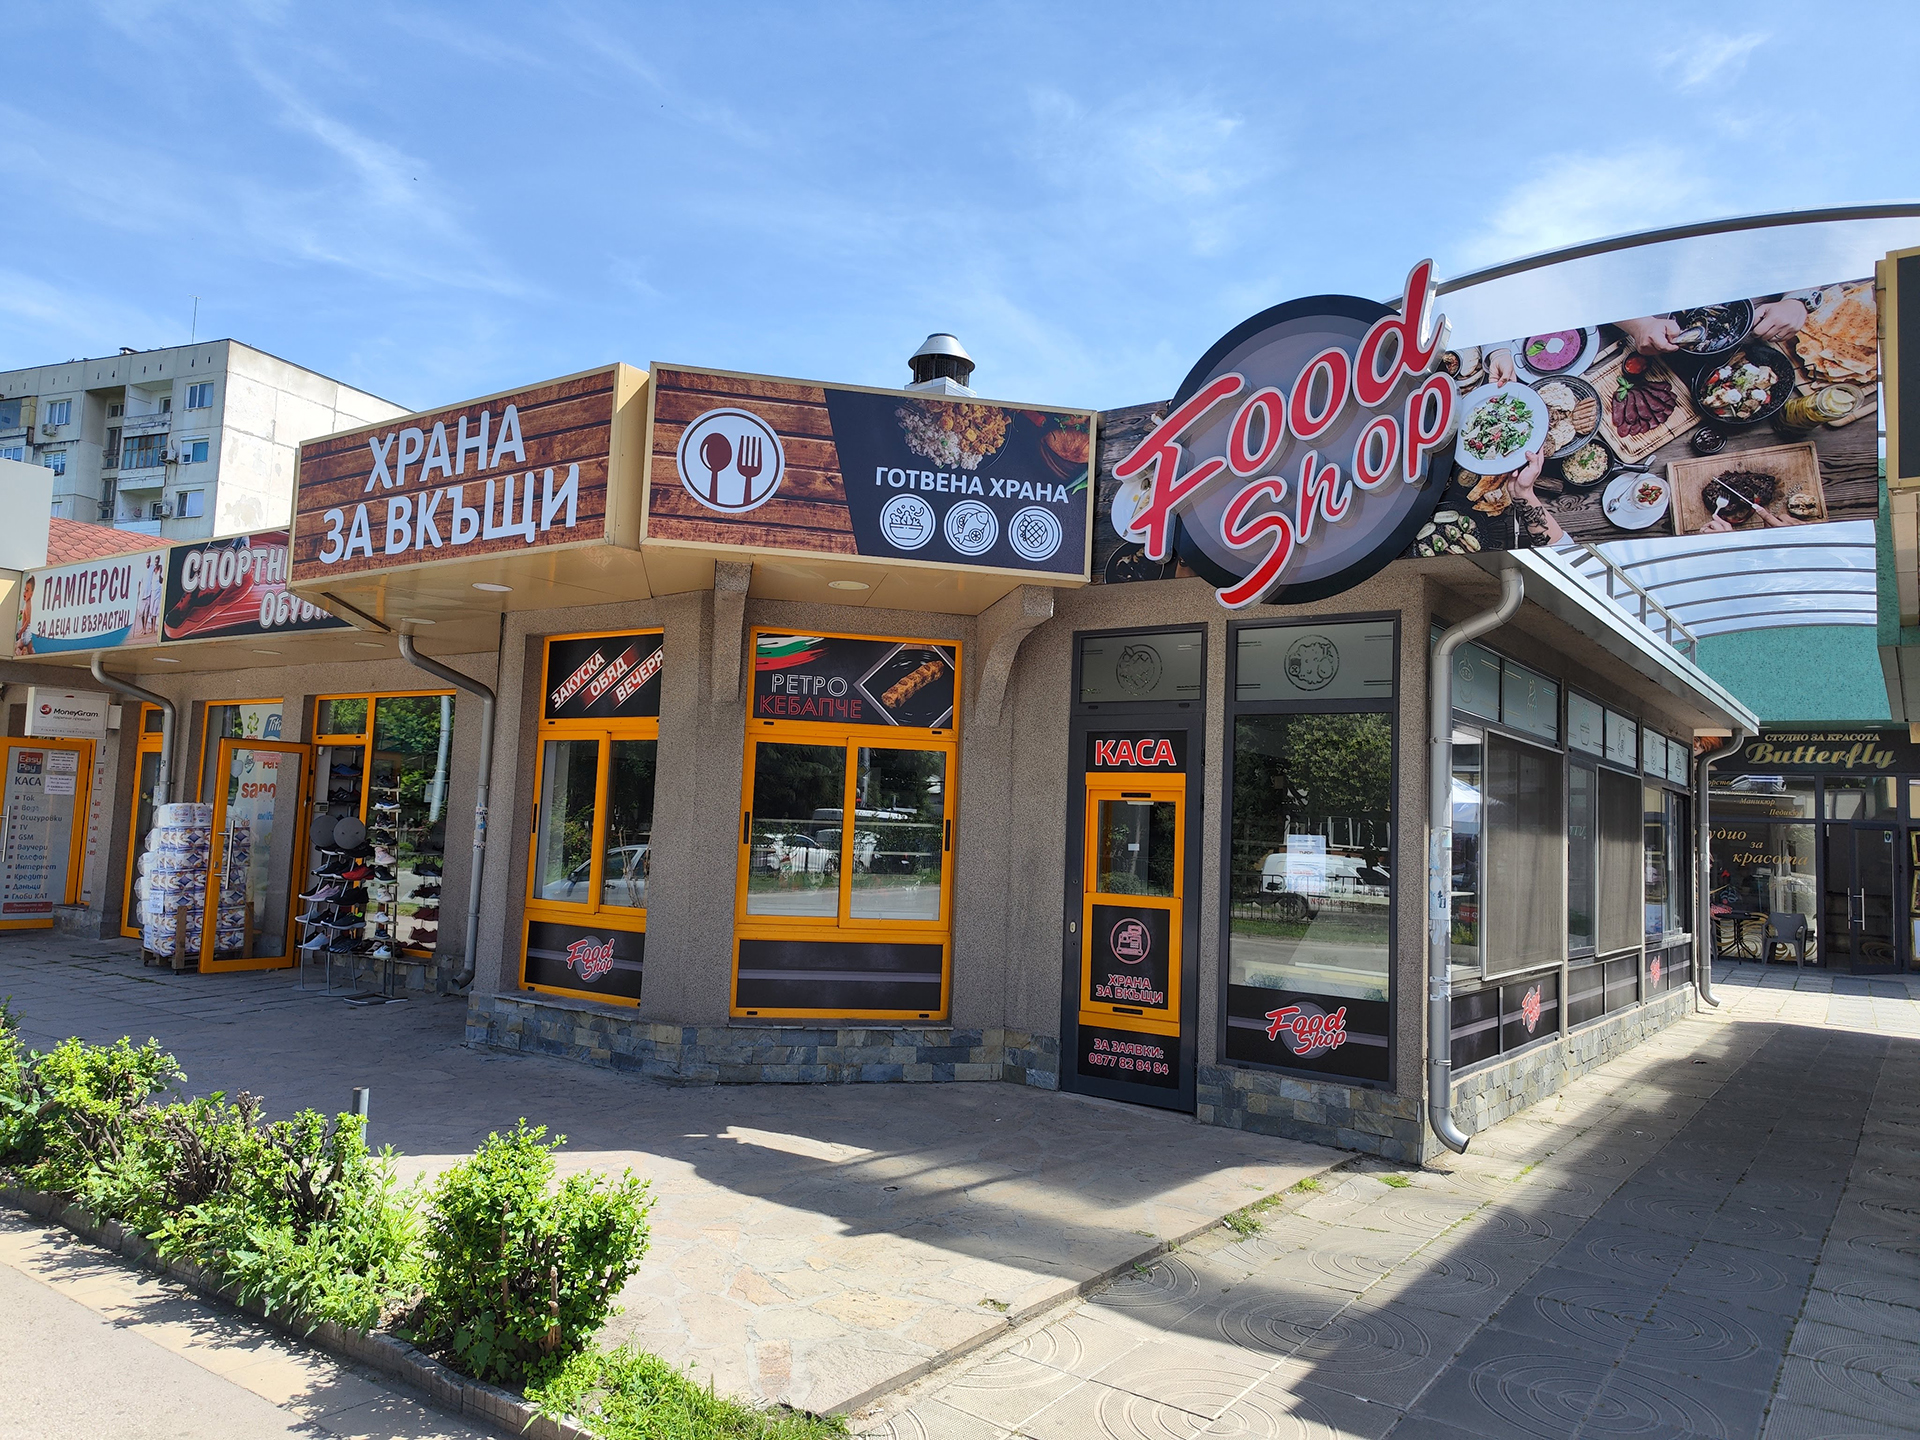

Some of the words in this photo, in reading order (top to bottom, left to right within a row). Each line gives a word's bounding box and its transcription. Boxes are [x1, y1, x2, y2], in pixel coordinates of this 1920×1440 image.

[1112, 258, 1450, 561] Food
[364, 404, 526, 492] ХРАНА
[875, 466, 984, 496] ГОТВЕНА
[989, 477, 1069, 504] ХРАНА
[1216, 372, 1457, 610] Shop
[319, 503, 373, 564] ЗА
[385, 463, 579, 555] ВКЪЩИ
[42, 565, 132, 610] ПАМПЕРСИ
[37, 618, 48, 635] ЗА
[48, 614, 71, 639] ДЕЦА
[73, 615, 80, 633] И
[82, 609, 130, 632] ВЪЗРАСТНИ
[551, 653, 605, 708] ЗАКУСКА
[590, 657, 628, 696] ОБЯД
[615, 650, 663, 701] ВЕЧЕРЯ
[771, 673, 848, 697] РЕТРО
[53, 708, 99, 718] MoneyGram
[759, 695, 862, 719] КЕБАПЧЕ
[1764, 733, 1809, 743] СТУДИО
[1810, 733, 1825, 742] ЗА
[1826, 733, 1881, 742] КРАСОТА
[20, 754, 42, 765] Easy
[1095, 738, 1177, 767] КАСА
[1745, 742, 1897, 769] Butterfly
[18, 763, 37, 773] Pay
[17, 844, 48, 852] Ваучери
[1749, 841, 1763, 849] за
[15, 863, 57, 871] Интернет
[1732, 852, 1809, 867] красота
[12, 883, 41, 891] Данъци
[14, 873, 48, 881] Кредити
[11, 892, 33, 900] Глоби
[566, 938, 615, 969] Food
[582, 957, 613, 980] Shop
[1107, 973, 1152, 990] ХРАНА
[1096, 985, 1113, 998] ЗА
[1114, 986, 1163, 1004] ВКЪЩИ
[1265, 1006, 1347, 1041] Food
[1093, 1038, 1110, 1051] ЗА
[1111, 1041, 1164, 1059] ЗАЯВКИ:
[1293, 1029, 1347, 1056] Shop
[1088, 1052, 1116, 1067] 0877
[1118, 1056, 1134, 1070] 82
[1136, 1059, 1151, 1072] 84
[1153, 1061, 1169, 1075] 84
